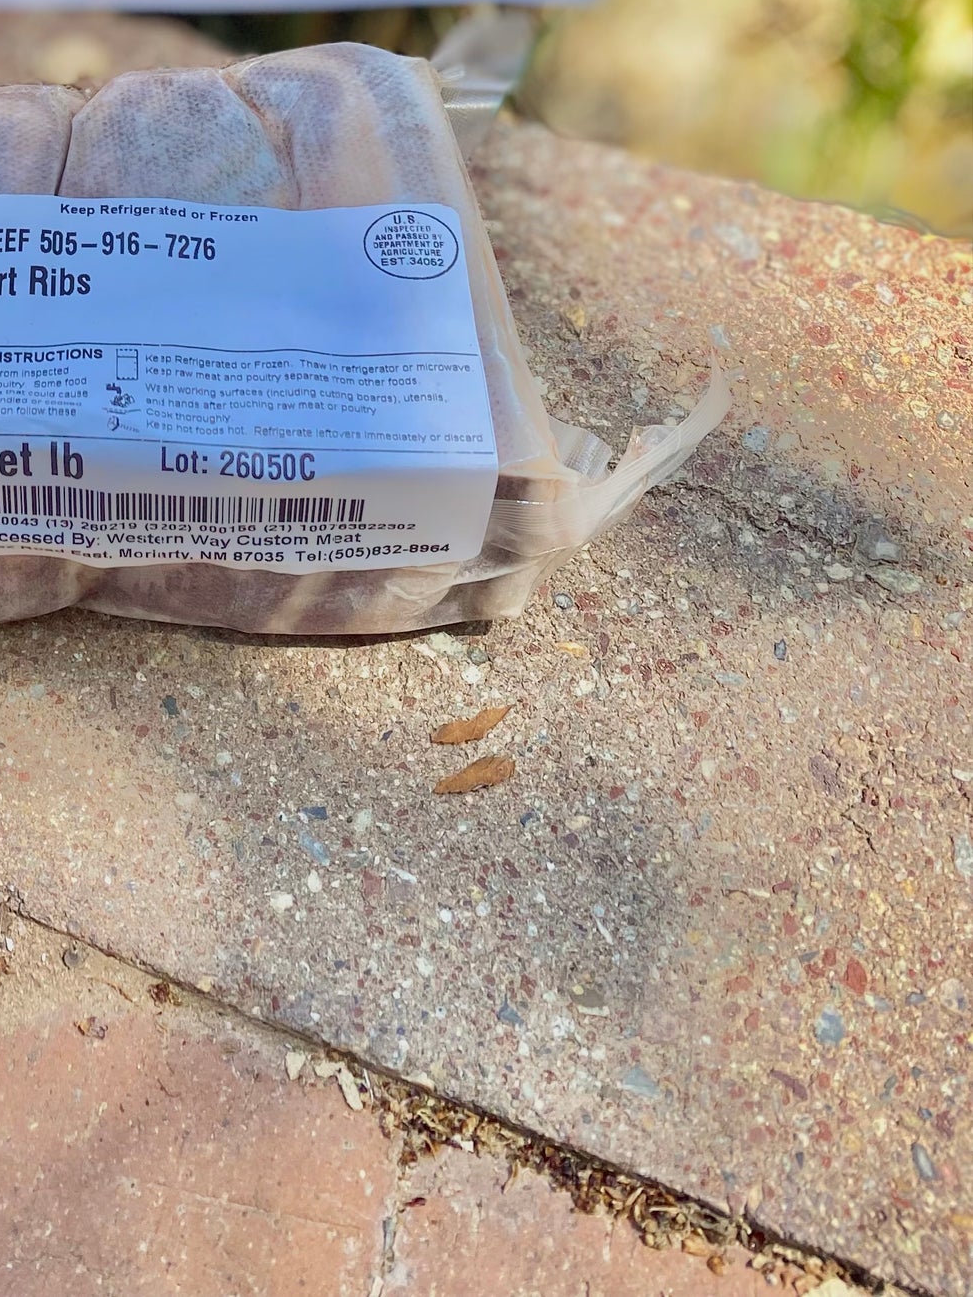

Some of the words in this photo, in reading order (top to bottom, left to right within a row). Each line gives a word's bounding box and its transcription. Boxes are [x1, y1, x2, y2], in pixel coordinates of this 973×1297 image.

[60, 204, 95, 217] Keep
[100, 204, 186, 217] Refrigerated
[191, 211, 205, 219] or
[210, 211, 258, 222] Frozen
[384, 225, 431, 233] INSPECTED
[375, 233, 393, 241] AND
[381, 248, 441, 256] AGRICULTURE
[29, 265, 91, 297] Ribs
[145, 354, 171, 364] Keep
[175, 355, 237, 369] Refrigerated
[300, 359, 326, 370] Thaw
[329, 363, 338, 371] in
[341, 364, 399, 375] refrigerator
[22, 367, 69, 379] inspected
[145, 367, 171, 377] Keep
[176, 370, 192, 378] raw
[196, 372, 221, 381] meat
[224, 372, 242, 382] and
[246, 372, 281, 386] poultry
[284, 373, 329, 382] separate
[332, 375, 355, 385] from
[358, 377, 384, 386] other
[33, 380, 62, 388] Some
[65, 377, 87, 387] food
[28, 390, 55, 398] could
[59, 390, 88, 398] cause
[145, 383, 174, 393] Wash
[177, 384, 216, 399] working
[220, 388, 263, 397] surfaces
[266, 387, 316, 398] (including
[320, 390, 353, 401] cutting
[146, 397, 165, 406] and
[168, 399, 199, 409] hands
[203, 400, 226, 410] after
[230, 400, 273, 410] touching
[298, 401, 324, 410] meat
[16, 407, 45, 415] follow
[48, 407, 76, 416] these
[146, 408, 173, 418] Cook
[146, 420, 173, 431] Keep
[177, 423, 192, 433] hot
[196, 425, 224, 435] foods
[254, 426, 312, 438] Refrigerate
[316, 428, 361, 439] leftovers
[364, 431, 427, 443] immediately
[430, 433, 440, 441] or
[444, 433, 483, 442] discard
[50, 441, 84, 480] lb
[162, 446, 208, 474] Lot:
[219, 450, 316, 481] 26050C
[46, 519, 74, 530] (13)
[145, 522, 192, 532] (3202)
[264, 524, 292, 533] (21)
[72, 533, 100, 548] By:
[107, 533, 184, 545] Western
[191, 534, 231, 549] Way
[237, 535, 309, 546] Custom
[316, 533, 362, 545] Meat
[200, 551, 227, 561] NM
[233, 551, 284, 562] 87035
